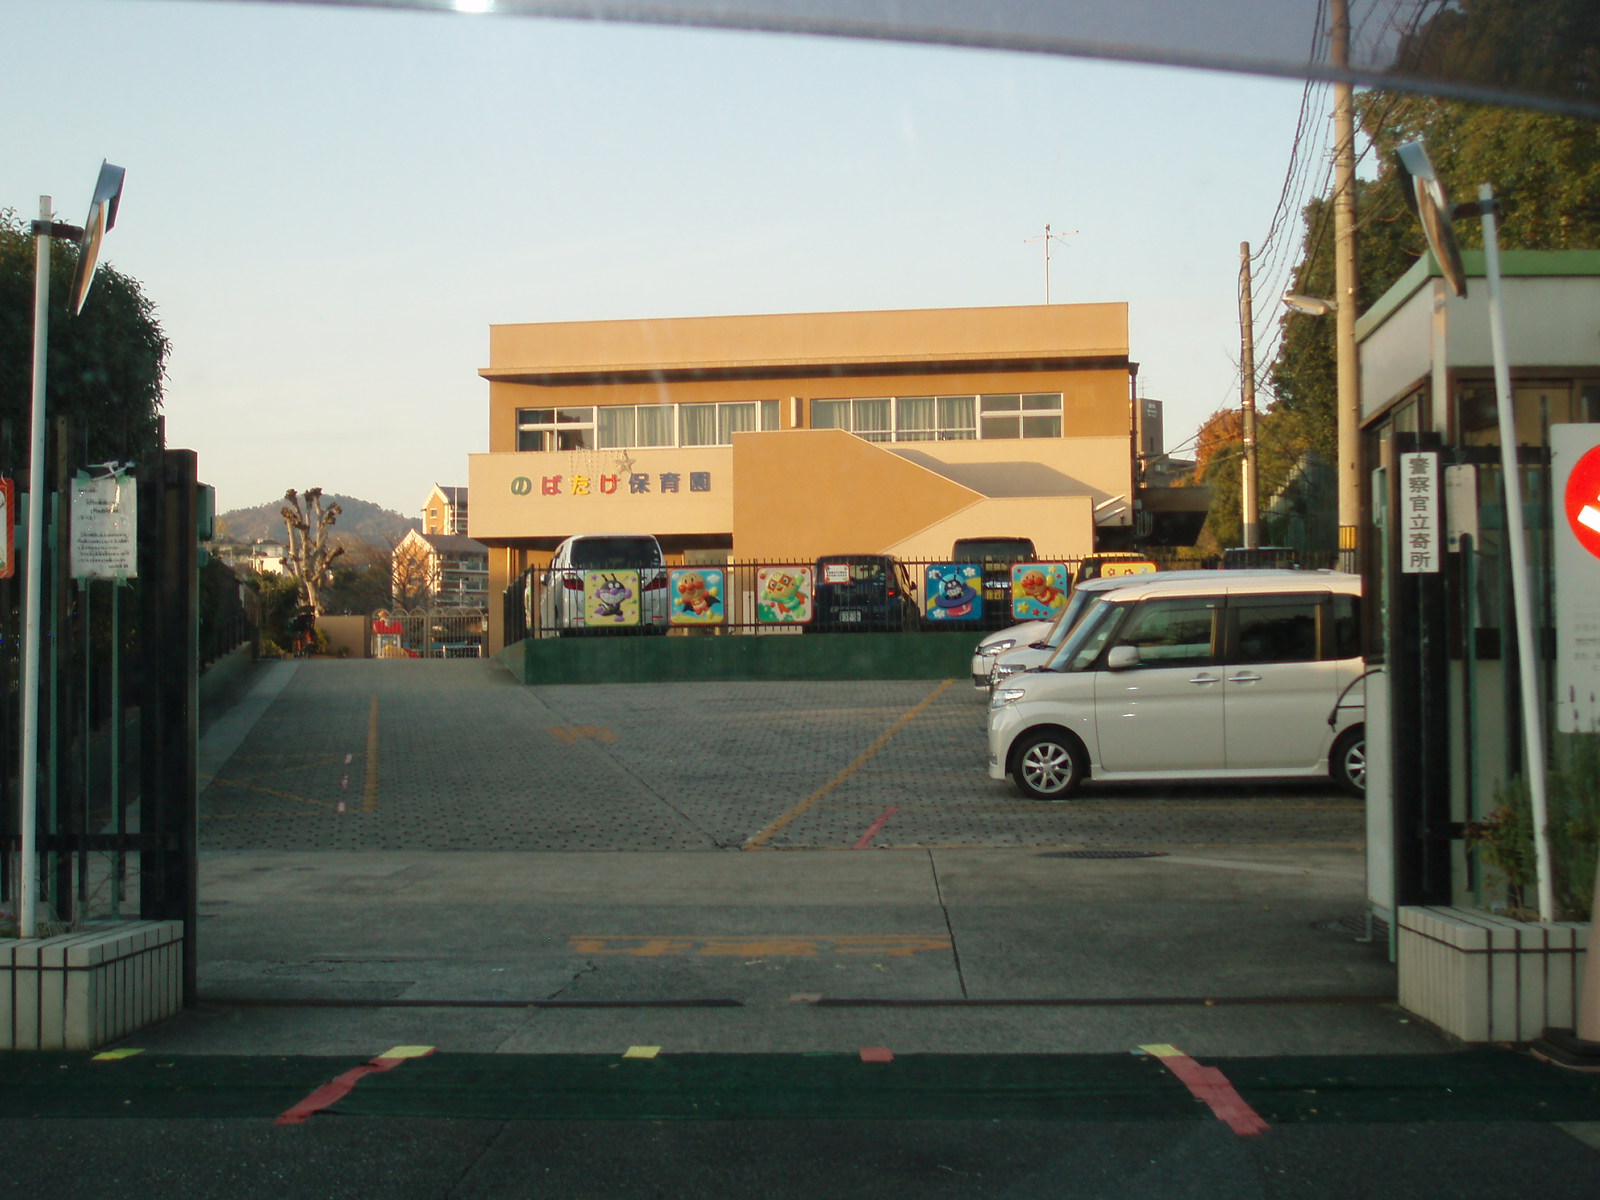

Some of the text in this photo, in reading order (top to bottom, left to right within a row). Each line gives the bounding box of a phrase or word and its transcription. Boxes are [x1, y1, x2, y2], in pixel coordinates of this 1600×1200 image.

[510, 471, 711, 496] のばたけ保育園
[1408, 457, 1431, 568] 警察官立寄所
